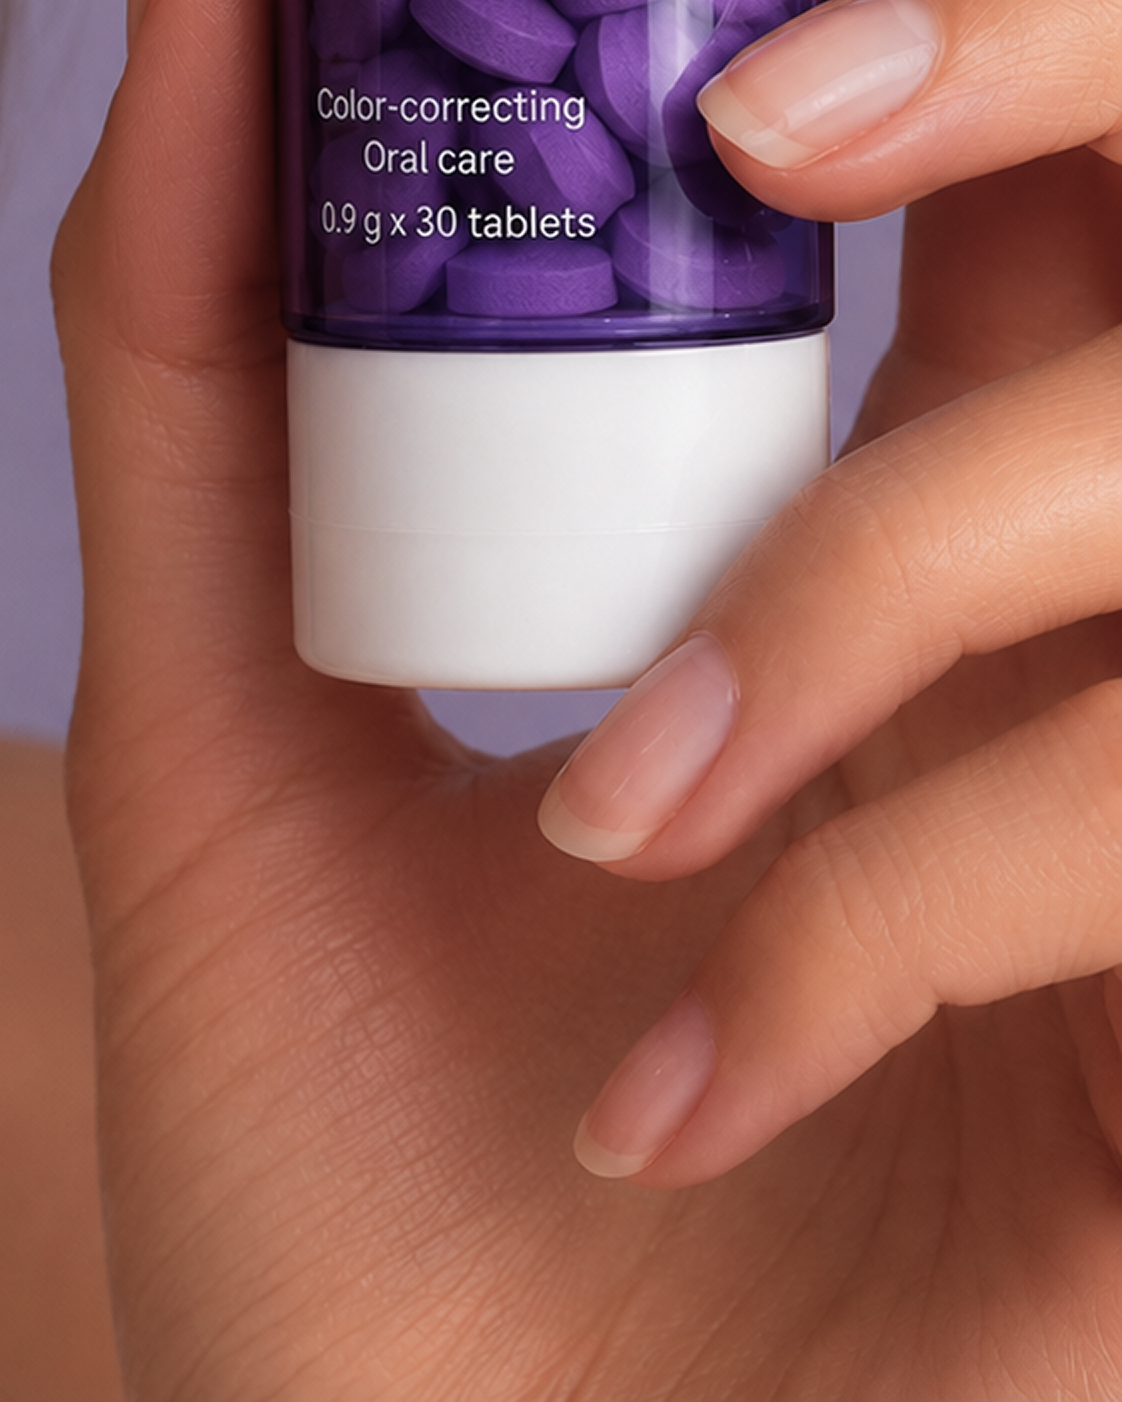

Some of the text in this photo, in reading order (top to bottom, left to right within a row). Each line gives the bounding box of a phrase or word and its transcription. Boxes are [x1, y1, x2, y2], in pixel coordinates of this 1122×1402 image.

[317, 87, 586, 130] Color-correcting
[364, 140, 515, 174] Oral care
[322, 201, 356, 234] 0.9
[390, 212, 407, 236] x
[416, 206, 457, 238] 30
[468, 205, 596, 238] tablets
